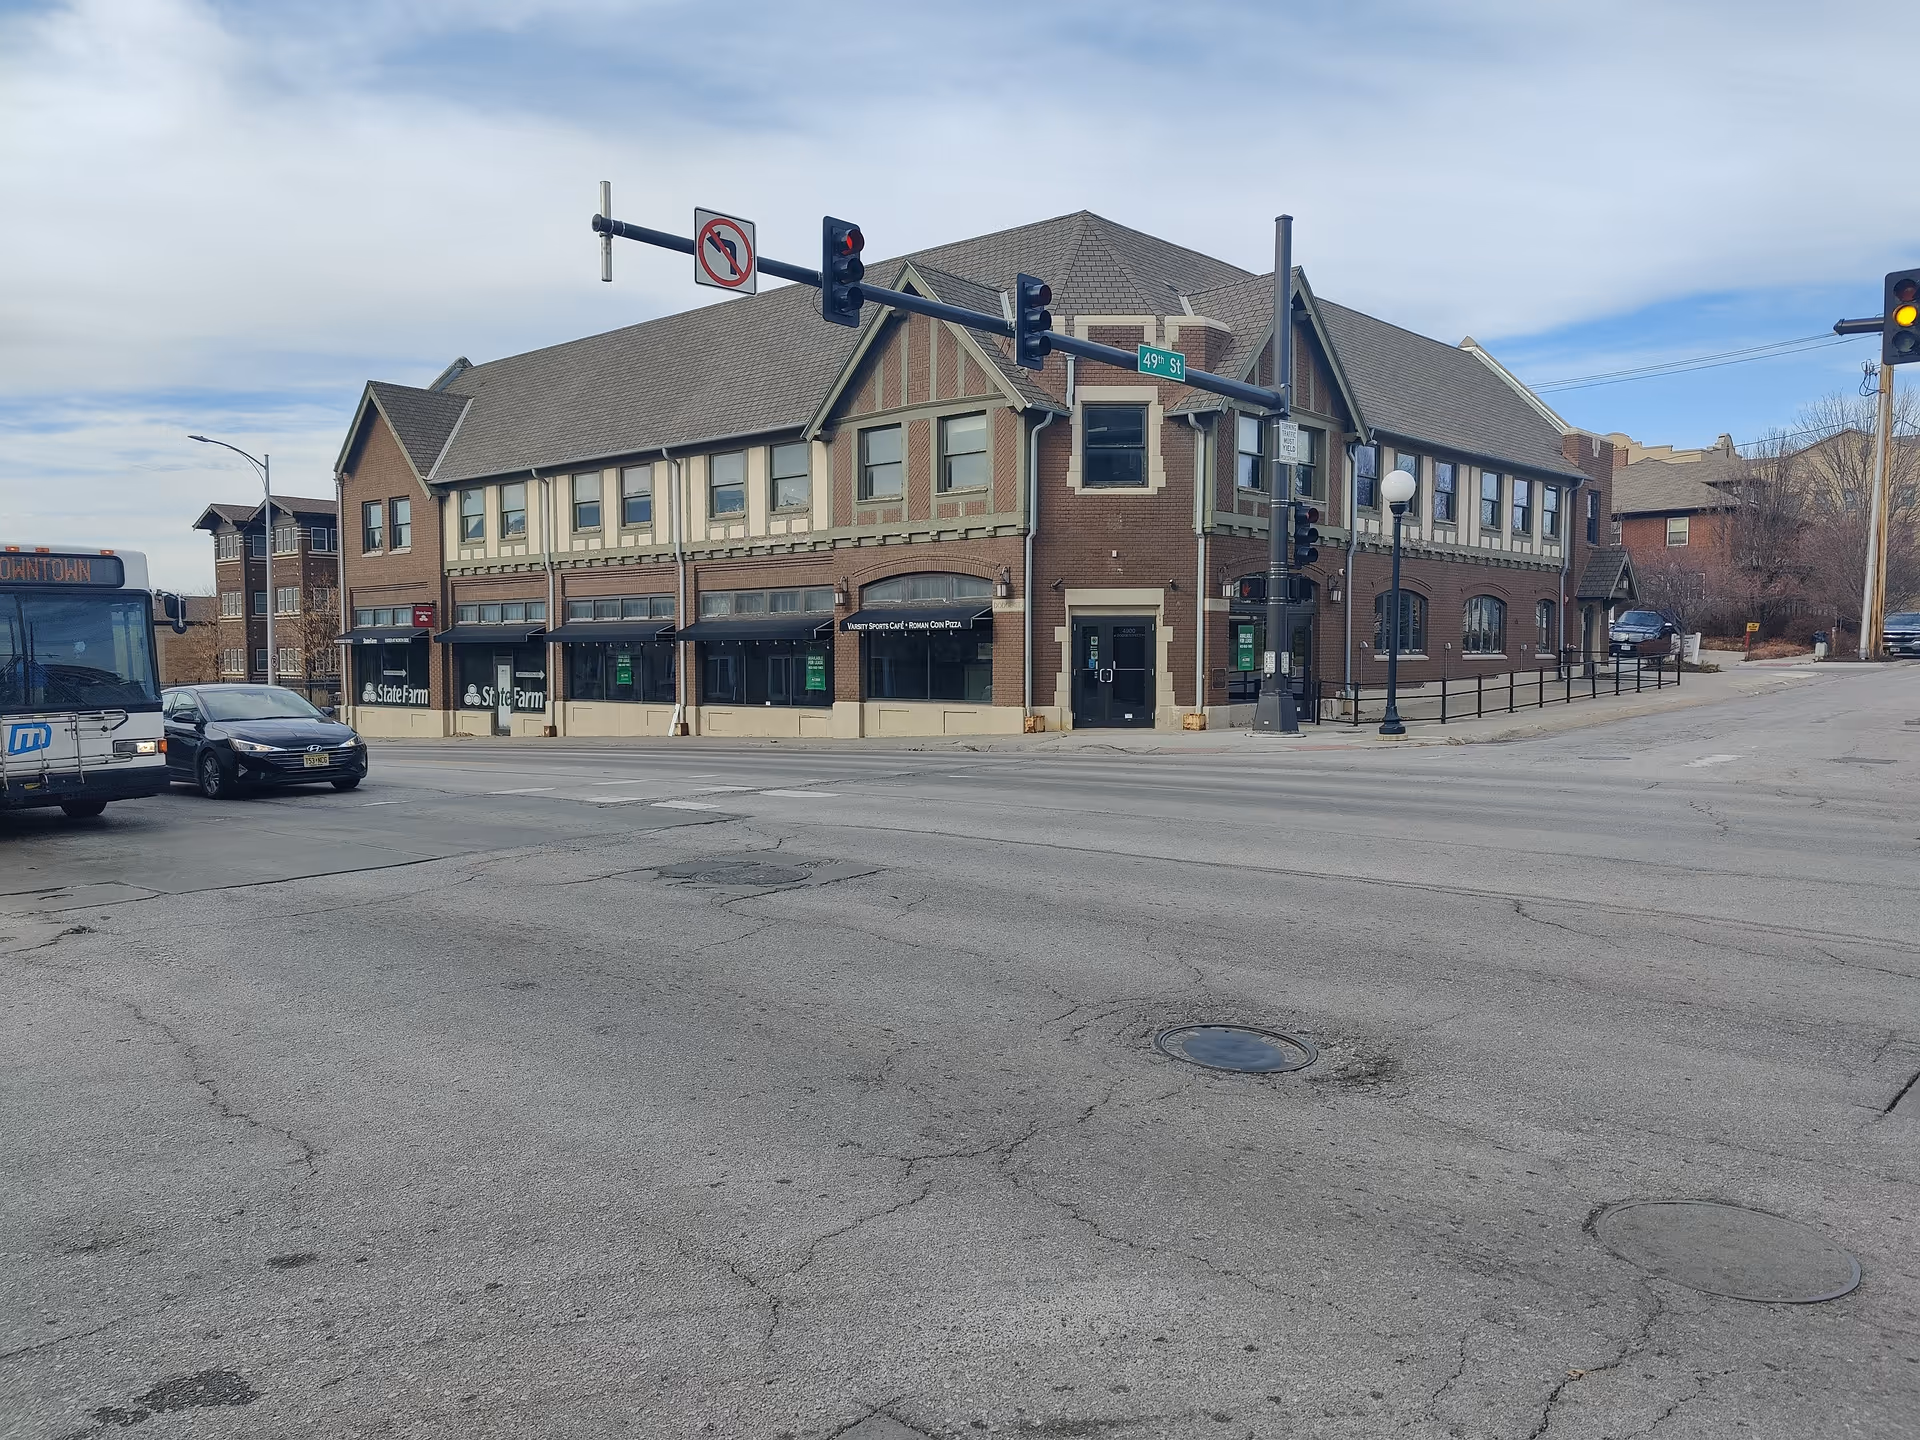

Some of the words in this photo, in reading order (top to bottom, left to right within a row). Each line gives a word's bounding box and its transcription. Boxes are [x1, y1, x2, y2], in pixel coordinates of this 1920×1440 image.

[1143, 352, 1165, 369] 49th
[1170, 357, 1181, 375] St
[1283, 437, 1296, 445] MUST
[1282, 444, 1297, 453] YIELD
[847, 622, 868, 630] VARSITY
[869, 622, 889, 630] SPORTS
[889, 620, 905, 630] CAFÉ
[909, 621, 929, 629] ROMAN
[930, 620, 945, 629] COIN
[945, 620, 962, 628] PIZZA
